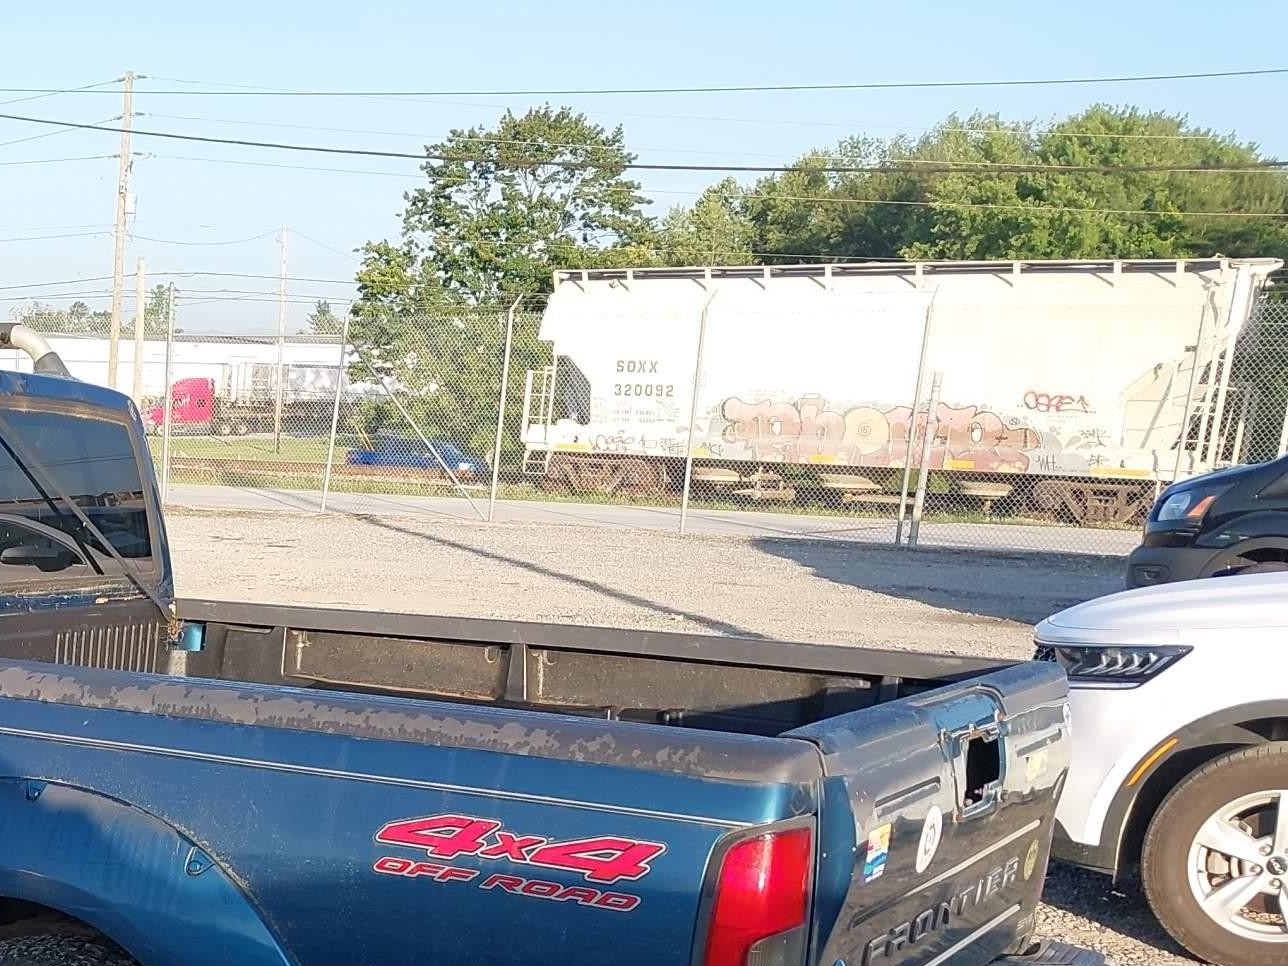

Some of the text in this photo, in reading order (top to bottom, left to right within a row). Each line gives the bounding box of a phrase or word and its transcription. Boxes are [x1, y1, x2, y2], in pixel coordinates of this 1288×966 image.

[616, 360, 659, 374] SOXX
[613, 383, 675, 398] 320092
[375, 813, 667, 884] 4x4
[373, 857, 642, 912] OFF ROAD
